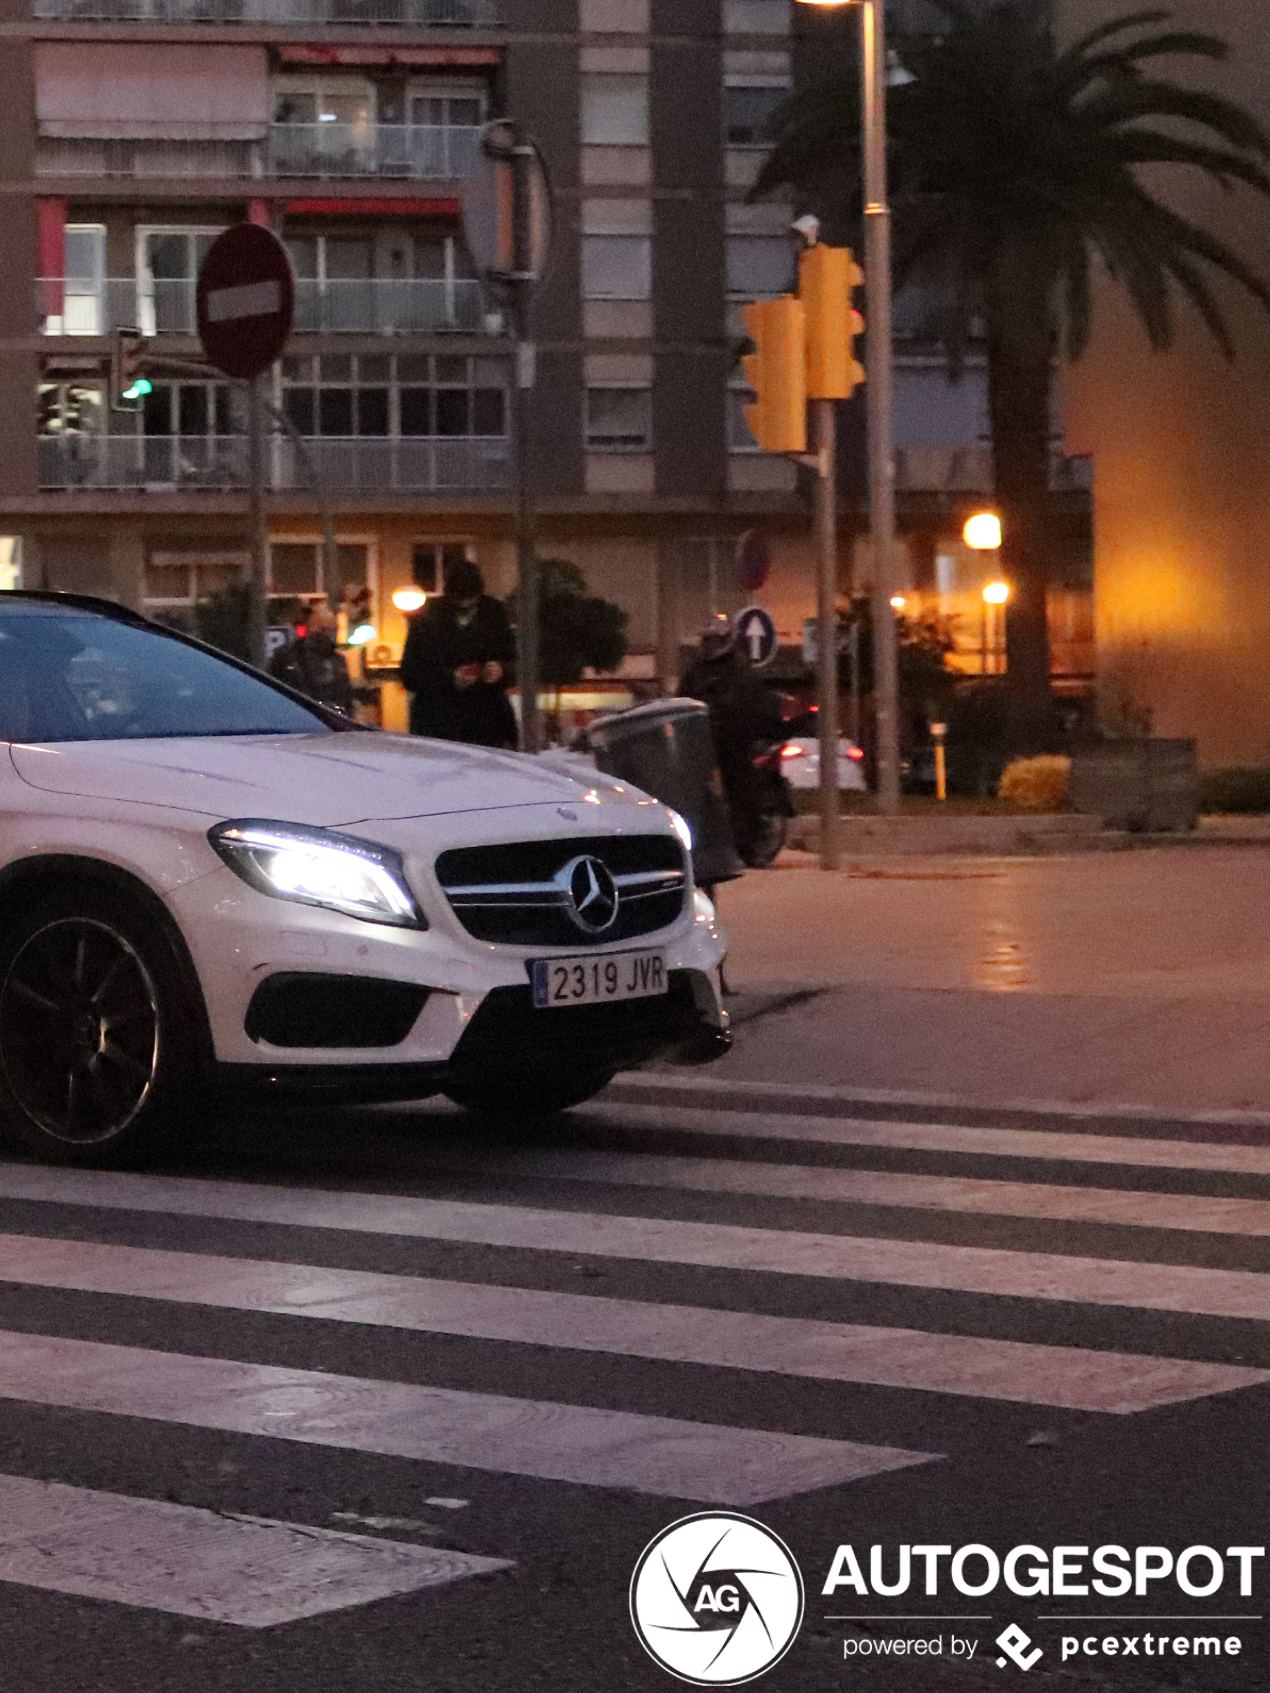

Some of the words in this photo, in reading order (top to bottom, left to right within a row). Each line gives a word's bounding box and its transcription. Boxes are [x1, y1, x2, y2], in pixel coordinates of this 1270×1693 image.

[266, 631, 285, 656] P
[553, 961, 618, 1000] 2319
[626, 955, 664, 991] JVR
